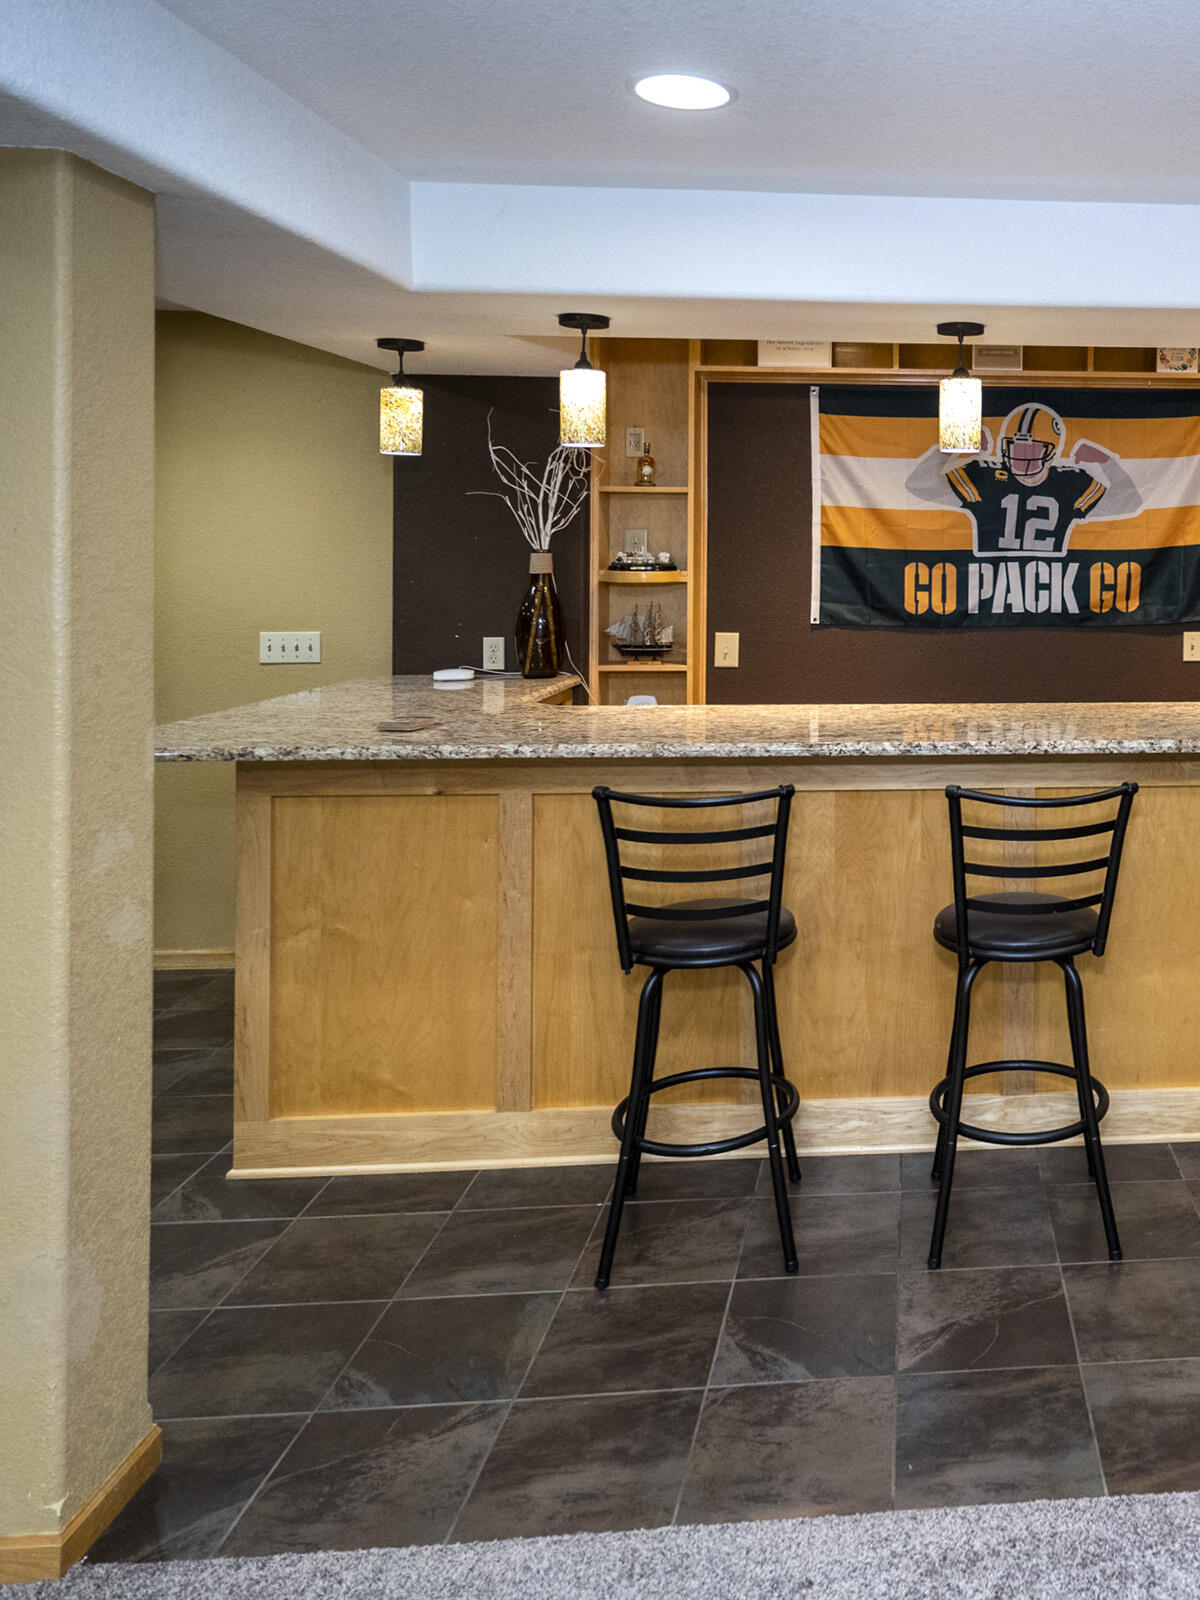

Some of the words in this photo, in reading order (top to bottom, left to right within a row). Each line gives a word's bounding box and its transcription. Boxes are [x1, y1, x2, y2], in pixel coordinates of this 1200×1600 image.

[998, 494, 1060, 551] 12
[904, 561, 958, 616] GO
[967, 560, 1080, 614] PACK
[1089, 561, 1142, 613] GO
